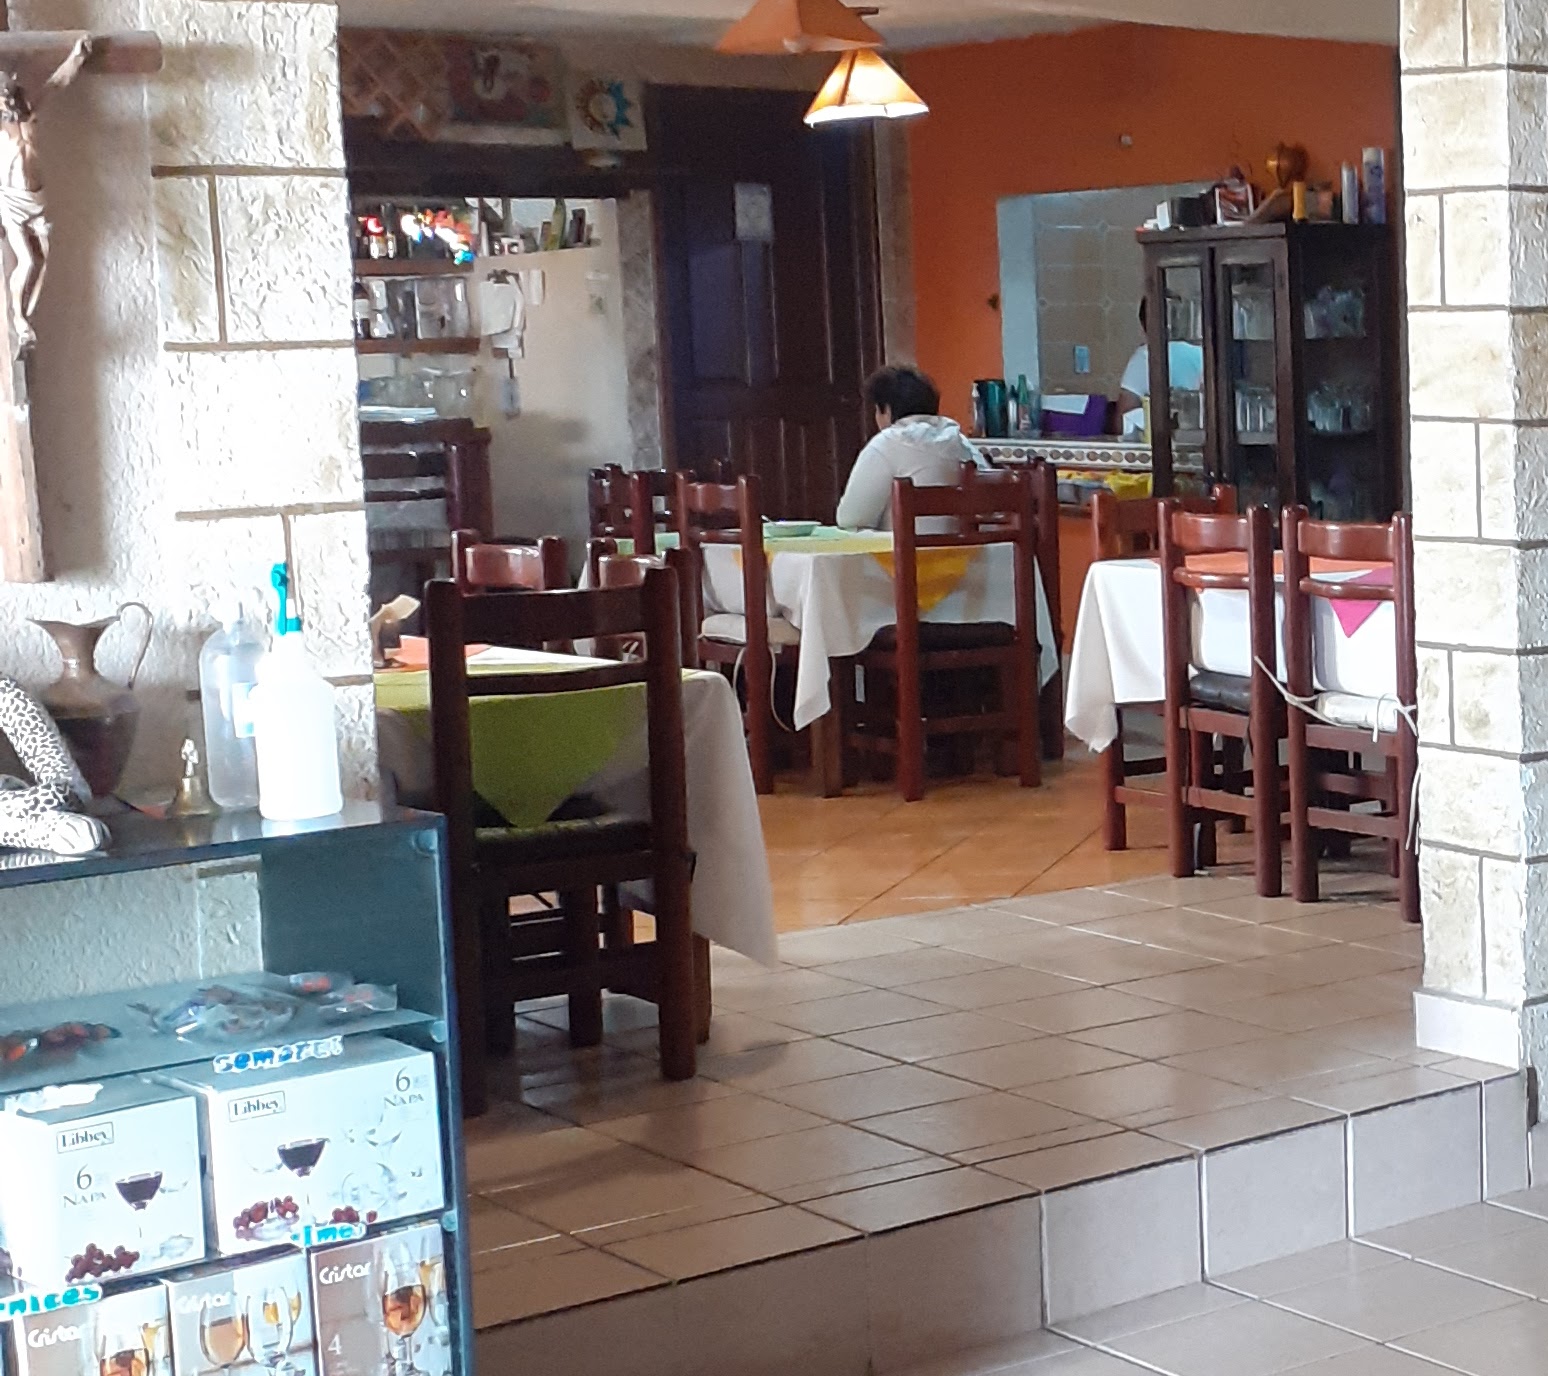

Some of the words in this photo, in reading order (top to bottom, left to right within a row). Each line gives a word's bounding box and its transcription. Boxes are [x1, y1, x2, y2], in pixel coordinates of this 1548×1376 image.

[395, 1066, 411, 1092] 6
[233, 1099, 279, 1116] Libbey
[76, 1164, 92, 1190] 6
[328, 1334, 342, 1356] 4
